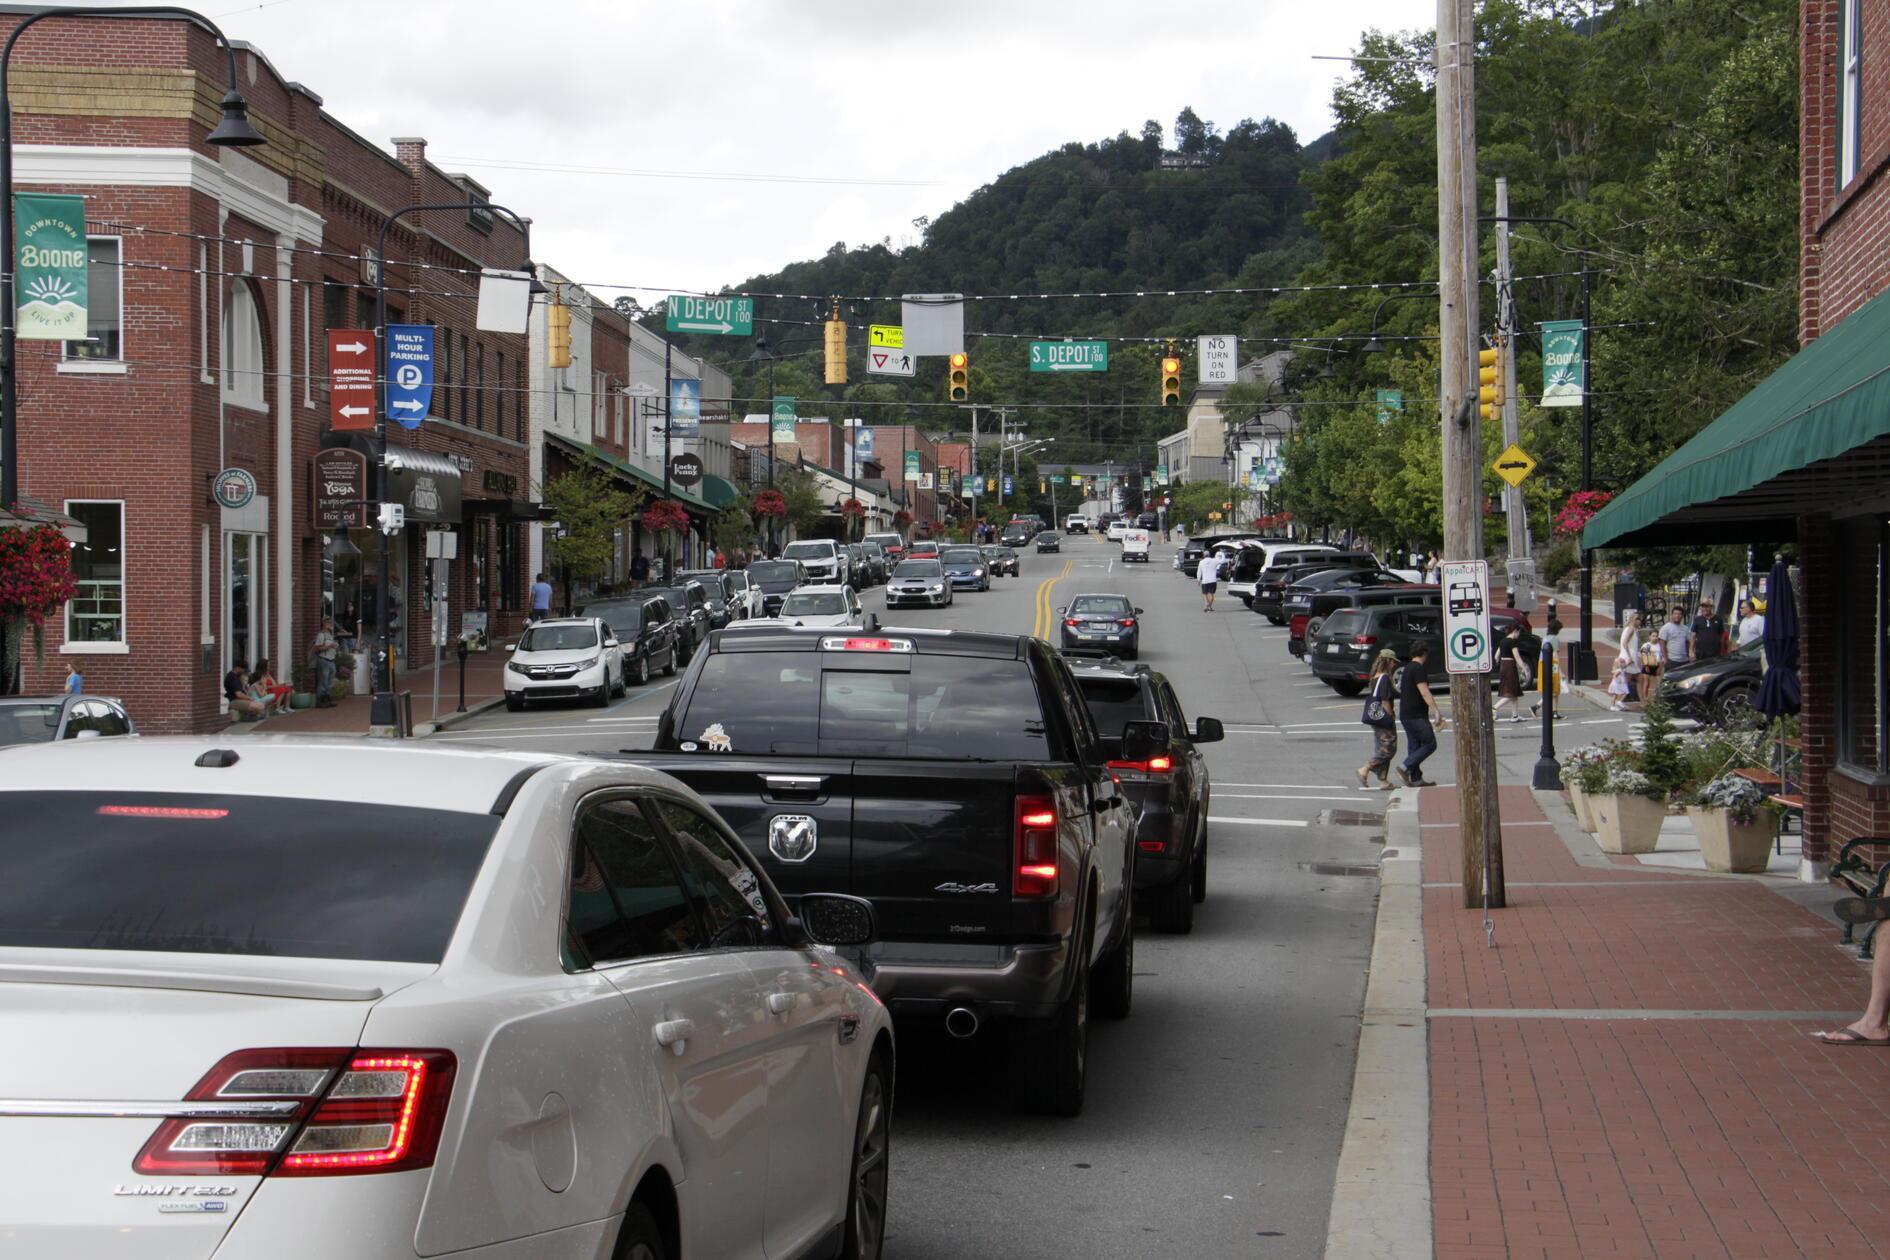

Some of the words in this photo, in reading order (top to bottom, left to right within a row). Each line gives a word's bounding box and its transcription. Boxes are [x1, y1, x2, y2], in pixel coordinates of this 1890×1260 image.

[25, 219, 77, 239] DOWNTOWN
[21, 245, 84, 268] Boone
[668, 299, 679, 318] N
[684, 299, 734, 321] DEPOT
[737, 301, 748, 312] ST
[31, 310, 50, 327] LIVE
[53, 318, 63, 327] IT
[63, 311, 76, 323] UP
[735, 312, 751, 323] 100
[395, 334, 425, 342] MULTI-
[1548, 335, 1578, 348] DOWNTOWN
[397, 343, 423, 352] HOUR
[1208, 340, 1226, 349] NO
[390, 352, 430, 361] PARKING
[1032, 346, 1046, 363] S.
[1049, 346, 1090, 363] DEPOT
[1090, 353, 1104, 362] 100
[1206, 351, 1229, 360] TURN
[1545, 352, 1580, 367] Boone
[1211, 361, 1224, 369] ON
[403, 368, 418, 385] P
[1209, 371, 1226, 379] RED
[674, 463, 698, 471] Lucky
[323, 481, 356, 496] Yoga
[1125, 534, 1147, 542] FedEx
[1461, 634, 1478, 655] P
[113, 1183, 238, 1196] LIMITED
